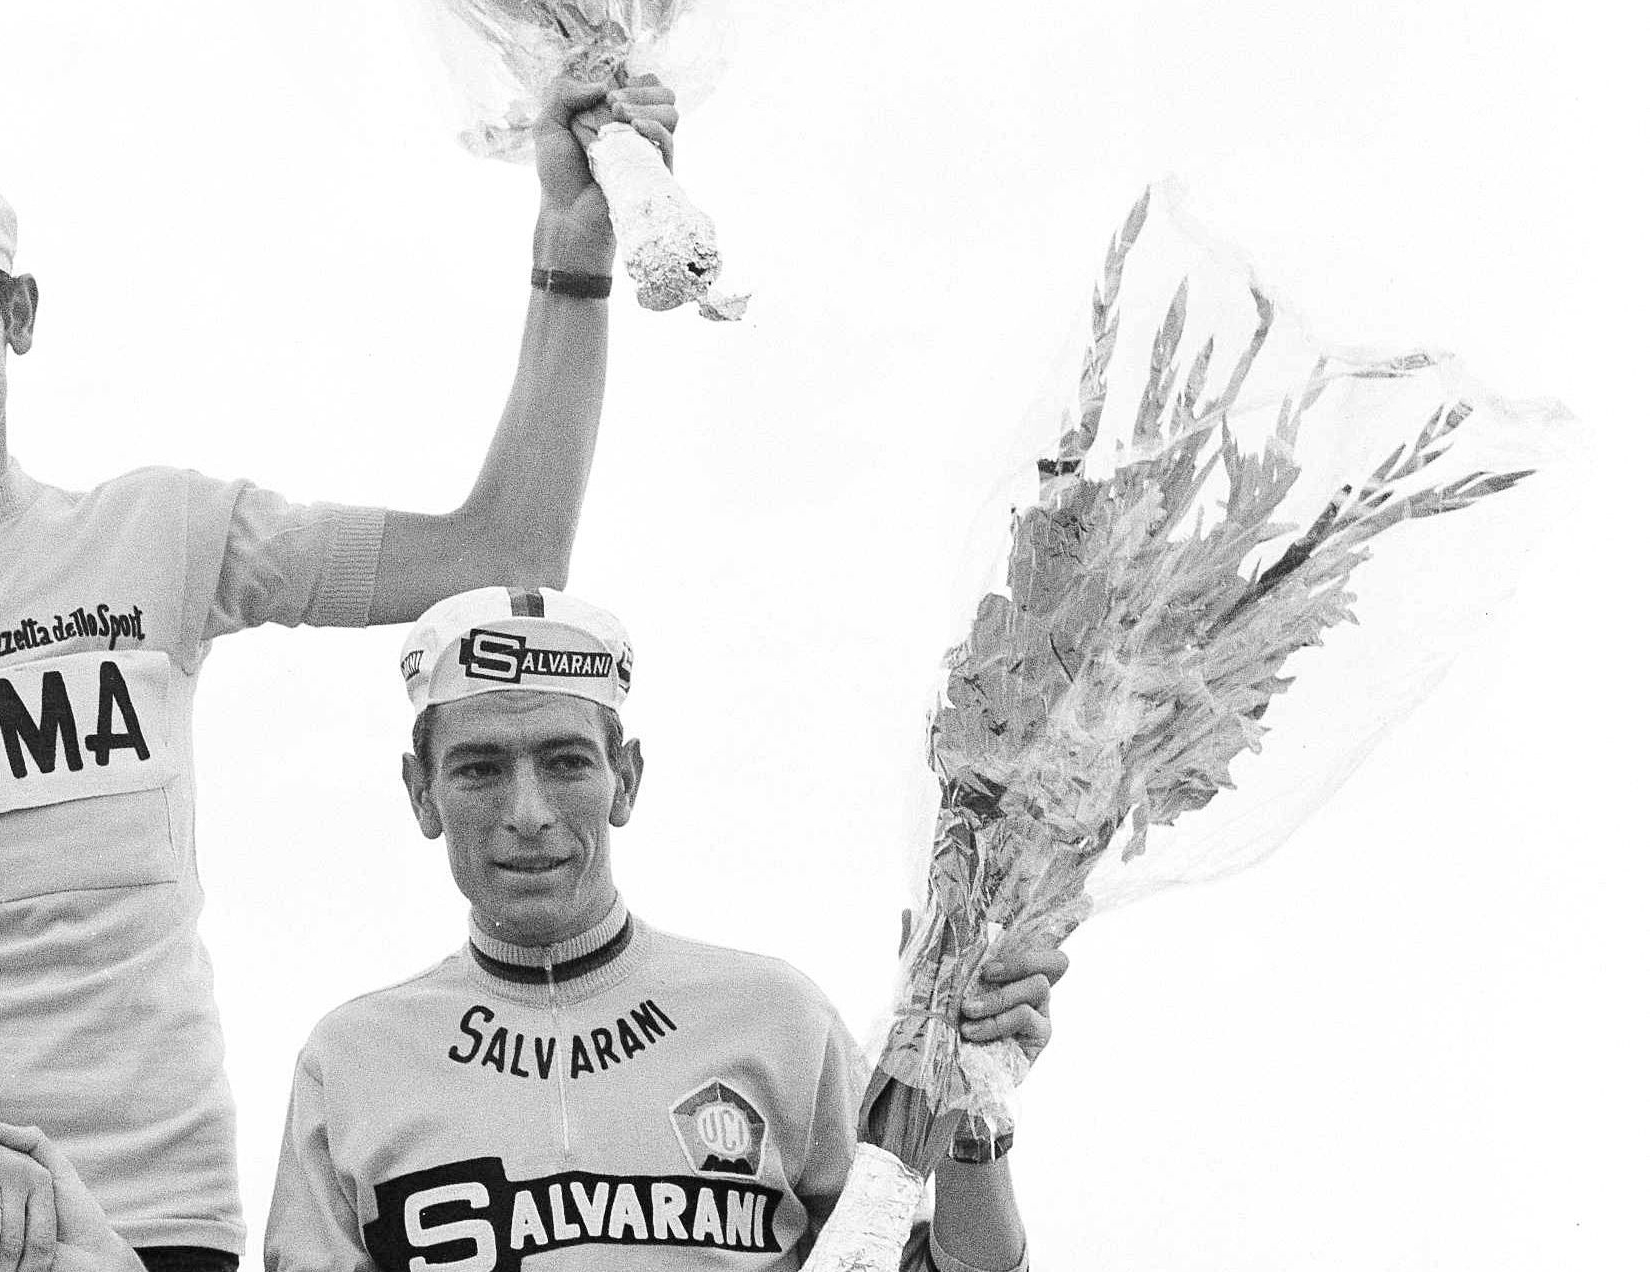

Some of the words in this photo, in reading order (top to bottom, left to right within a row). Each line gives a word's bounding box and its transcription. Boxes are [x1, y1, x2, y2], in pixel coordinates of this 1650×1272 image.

[52, 607, 98, 642] dello
[97, 604, 145, 650] Sport
[471, 633, 610, 679] SALVARANI
[448, 999, 678, 1080] SALVARANI
